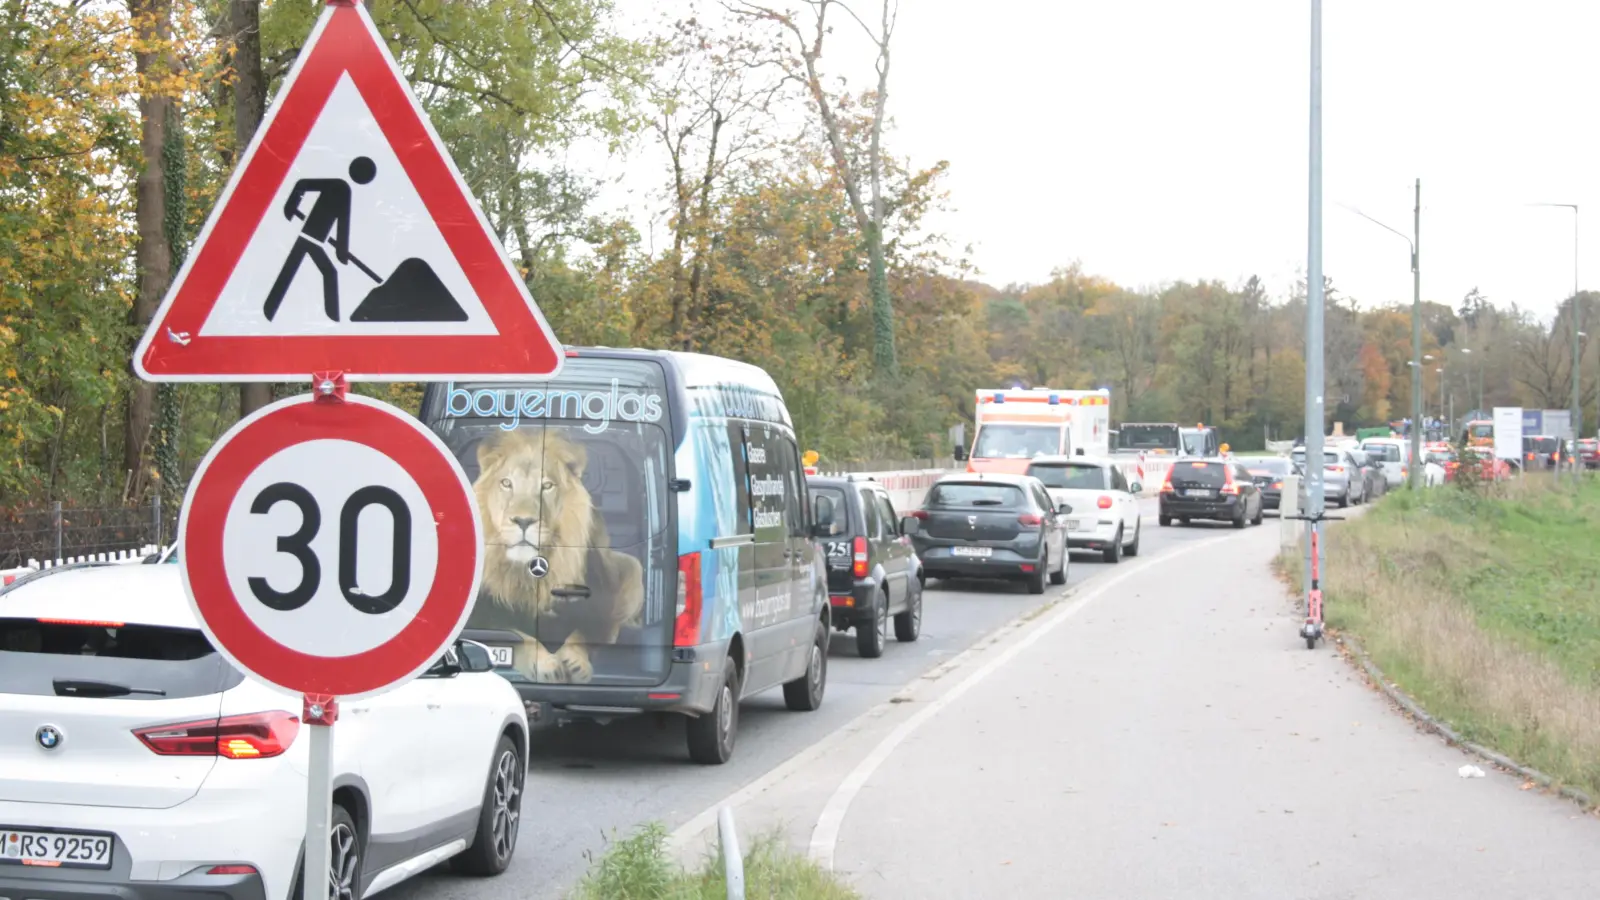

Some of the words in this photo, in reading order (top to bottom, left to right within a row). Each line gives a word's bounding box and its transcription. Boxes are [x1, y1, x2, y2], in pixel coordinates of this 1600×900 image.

[446, 378, 662, 434] bayernglas
[248, 481, 412, 615] 30
[827, 541, 847, 557] 25
[20, 834, 49, 858] RS
[53, 836, 108, 861] 9259
